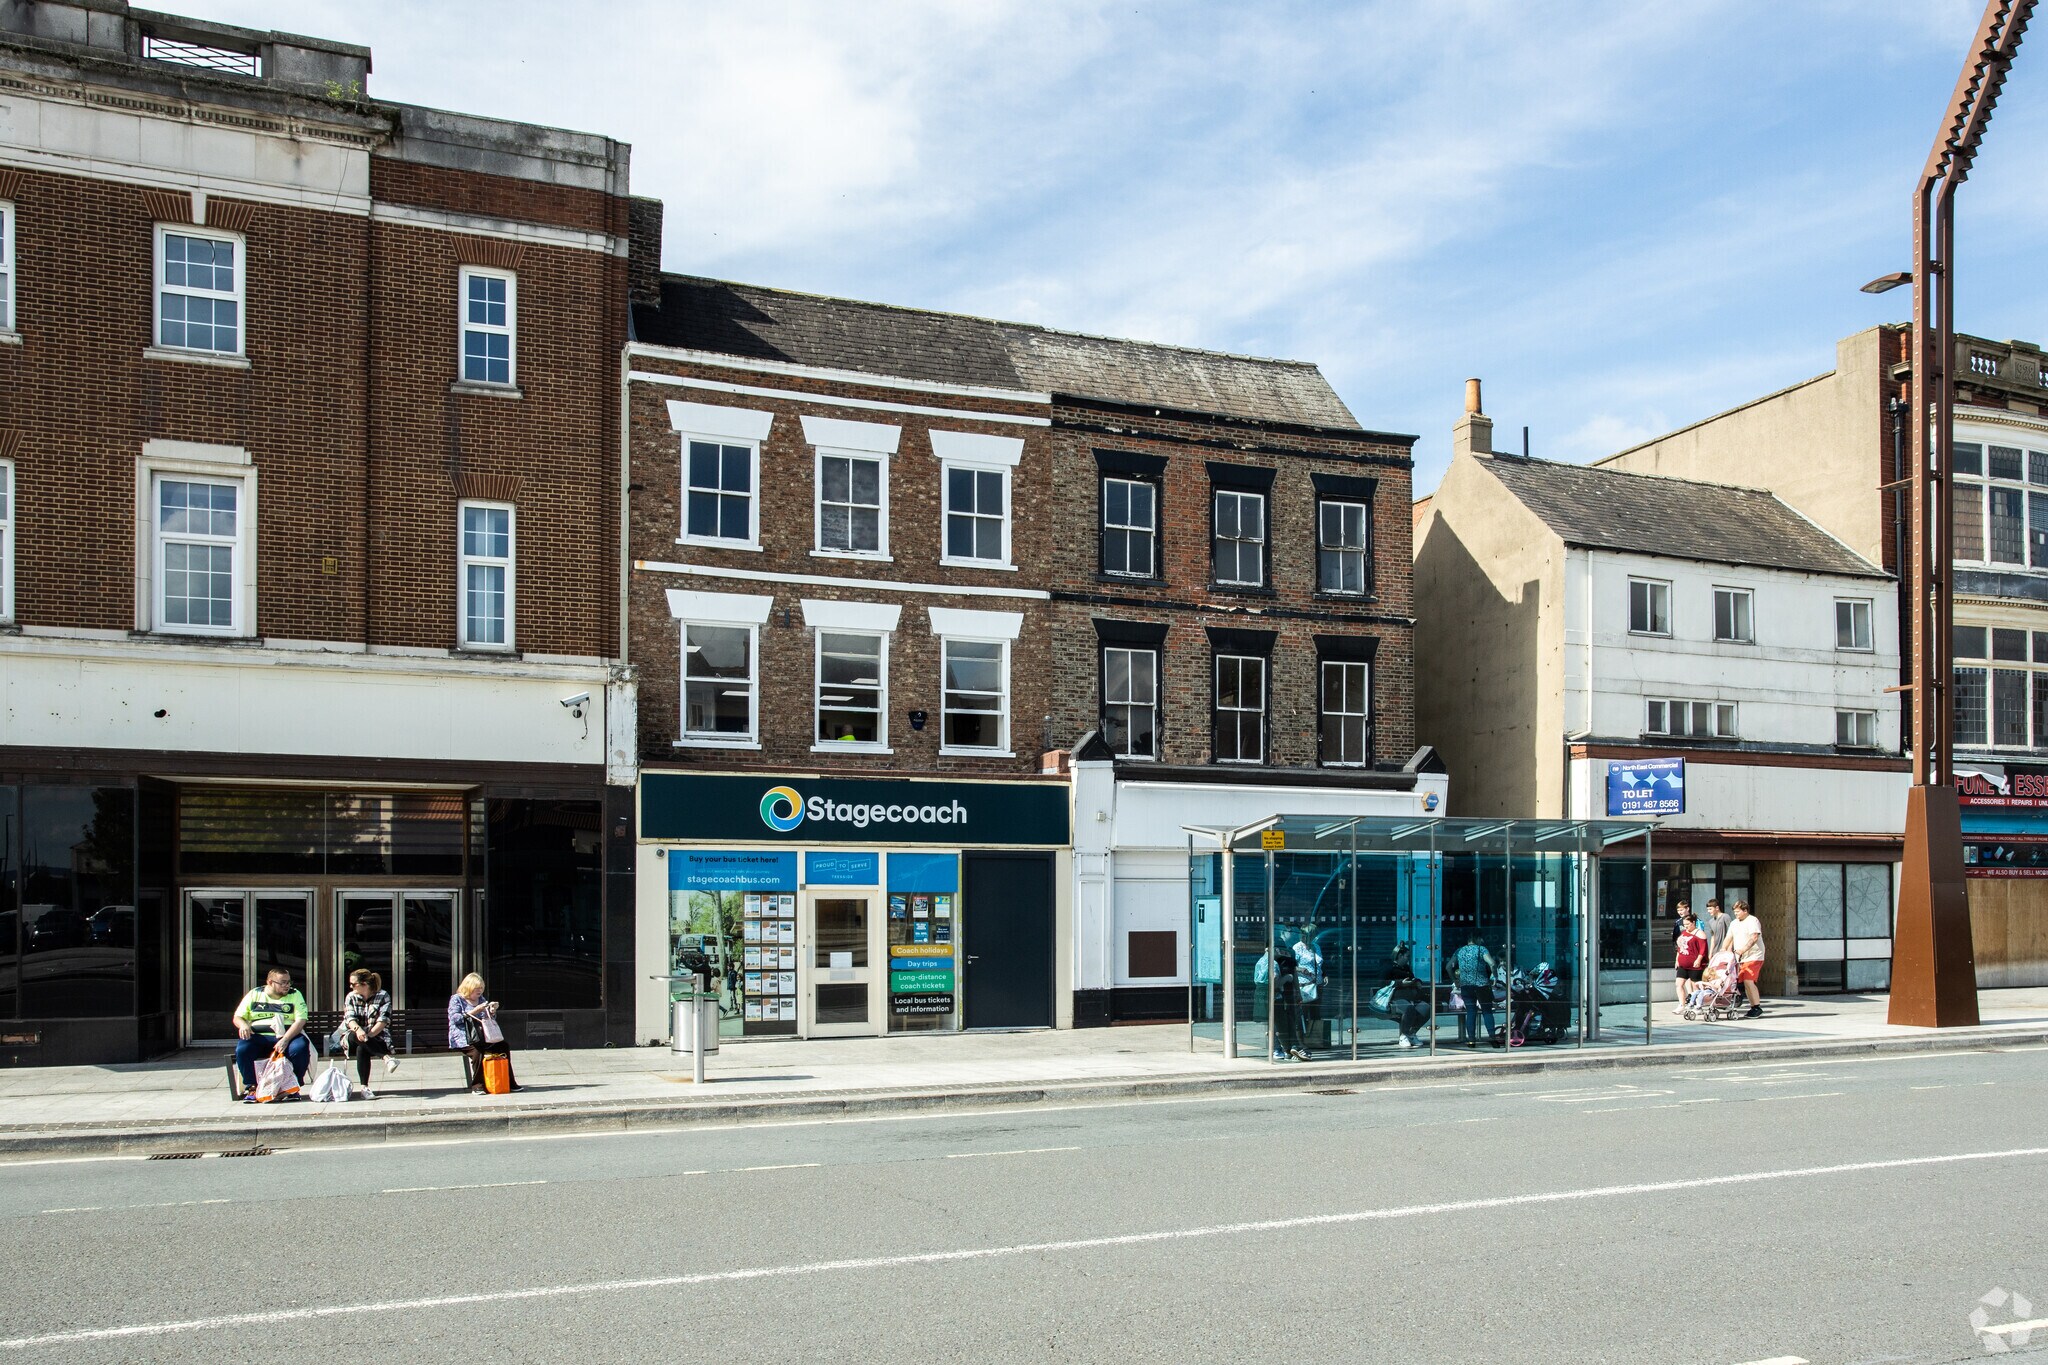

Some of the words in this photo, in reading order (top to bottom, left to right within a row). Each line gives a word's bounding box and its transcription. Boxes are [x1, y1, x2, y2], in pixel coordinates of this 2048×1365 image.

[1998, 774, 2011, 795] &
[1636, 789, 1654, 798] LET
[806, 796, 967, 828] Stagecoach
[687, 875, 780, 884] stagecoachbus.com
